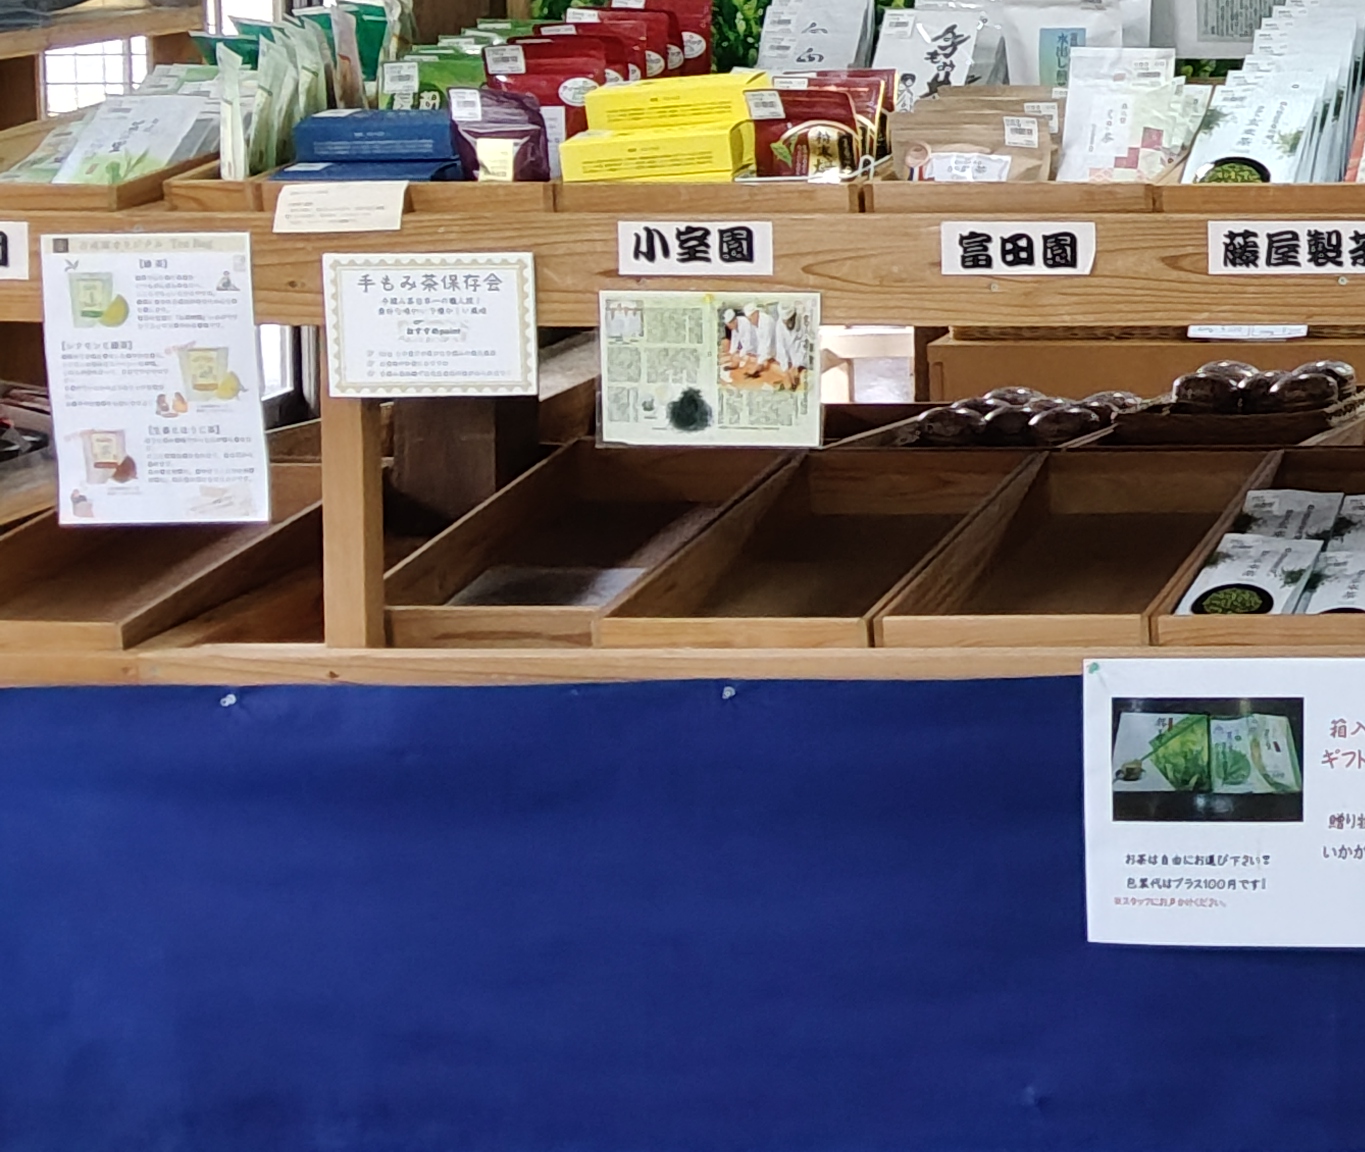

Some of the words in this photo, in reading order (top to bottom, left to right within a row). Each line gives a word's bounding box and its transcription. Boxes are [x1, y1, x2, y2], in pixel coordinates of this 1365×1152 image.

[633, 224, 755, 264] 小室園
[957, 230, 1080, 270] 富田園
[357, 272, 503, 293] 手もみ茶保存会
